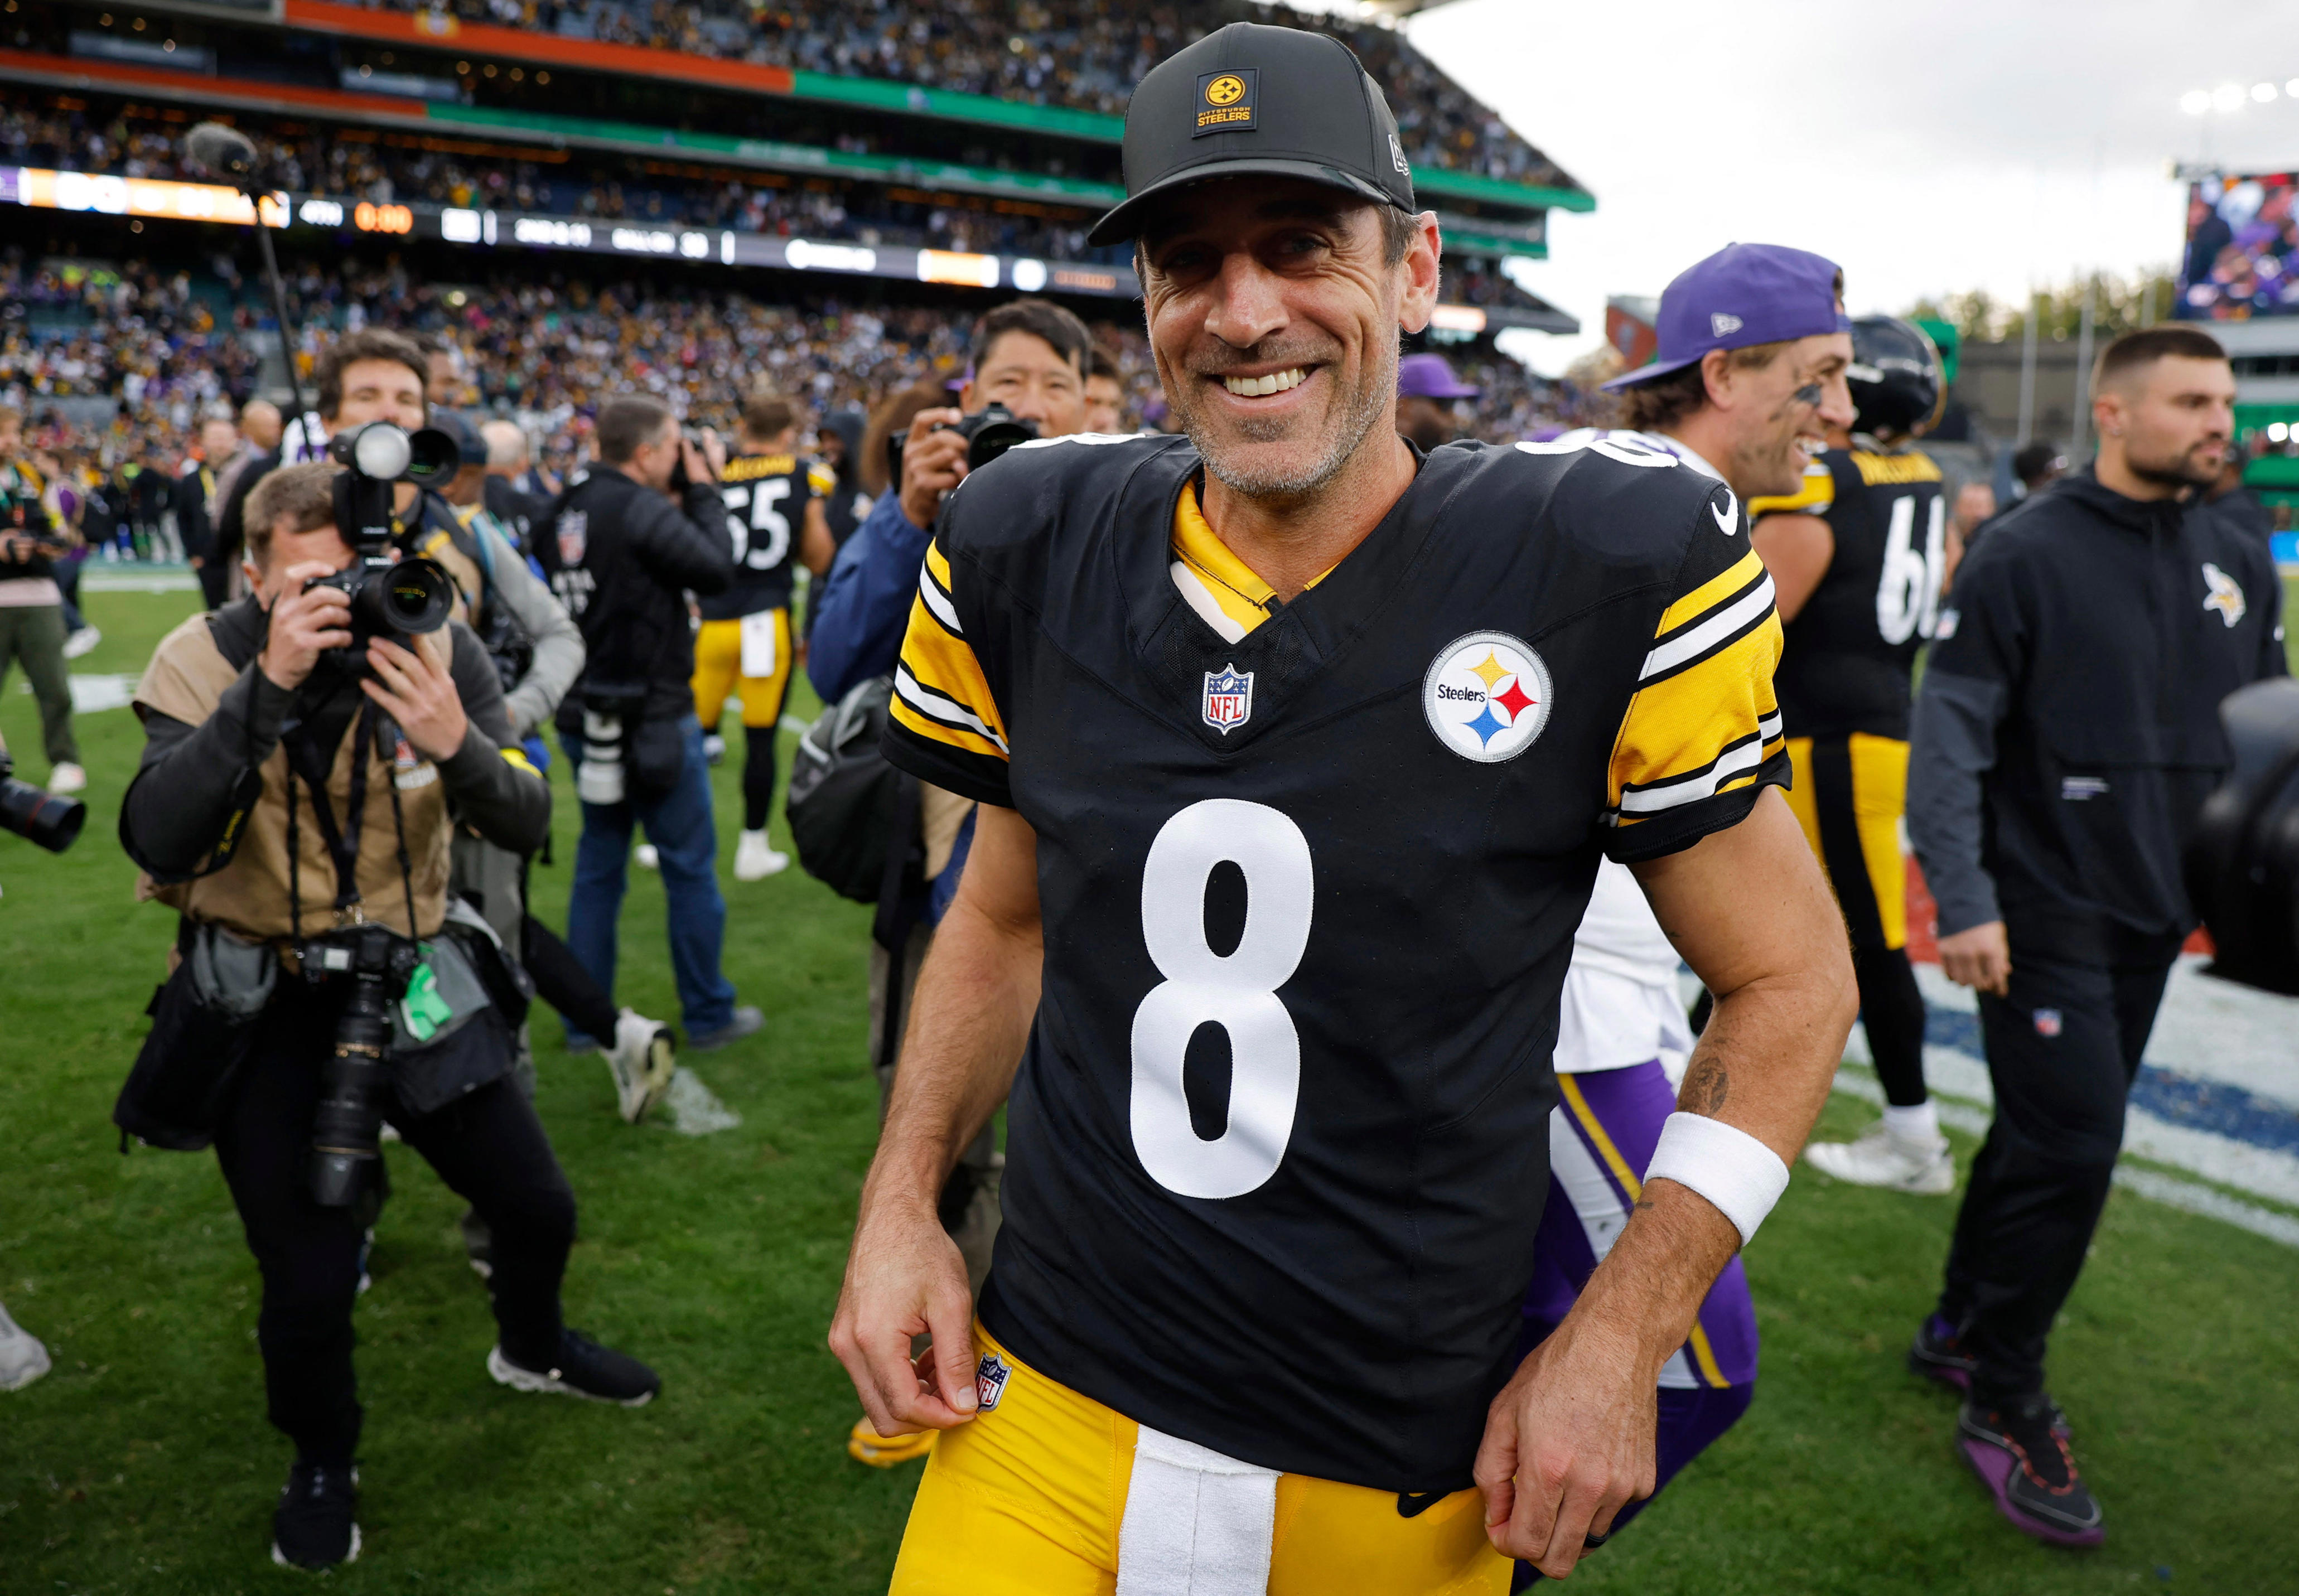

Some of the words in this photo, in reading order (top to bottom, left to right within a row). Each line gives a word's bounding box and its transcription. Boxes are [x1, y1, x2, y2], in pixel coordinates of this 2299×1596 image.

[1198, 107, 1250, 118] PITTSBURGH
[1198, 112, 1250, 127] STEELERS
[1437, 684, 1486, 703] Steelers
[1209, 696, 1243, 722] NFL
[1130, 798, 1315, 1200] 8
[976, 1376, 995, 1403] NFL
